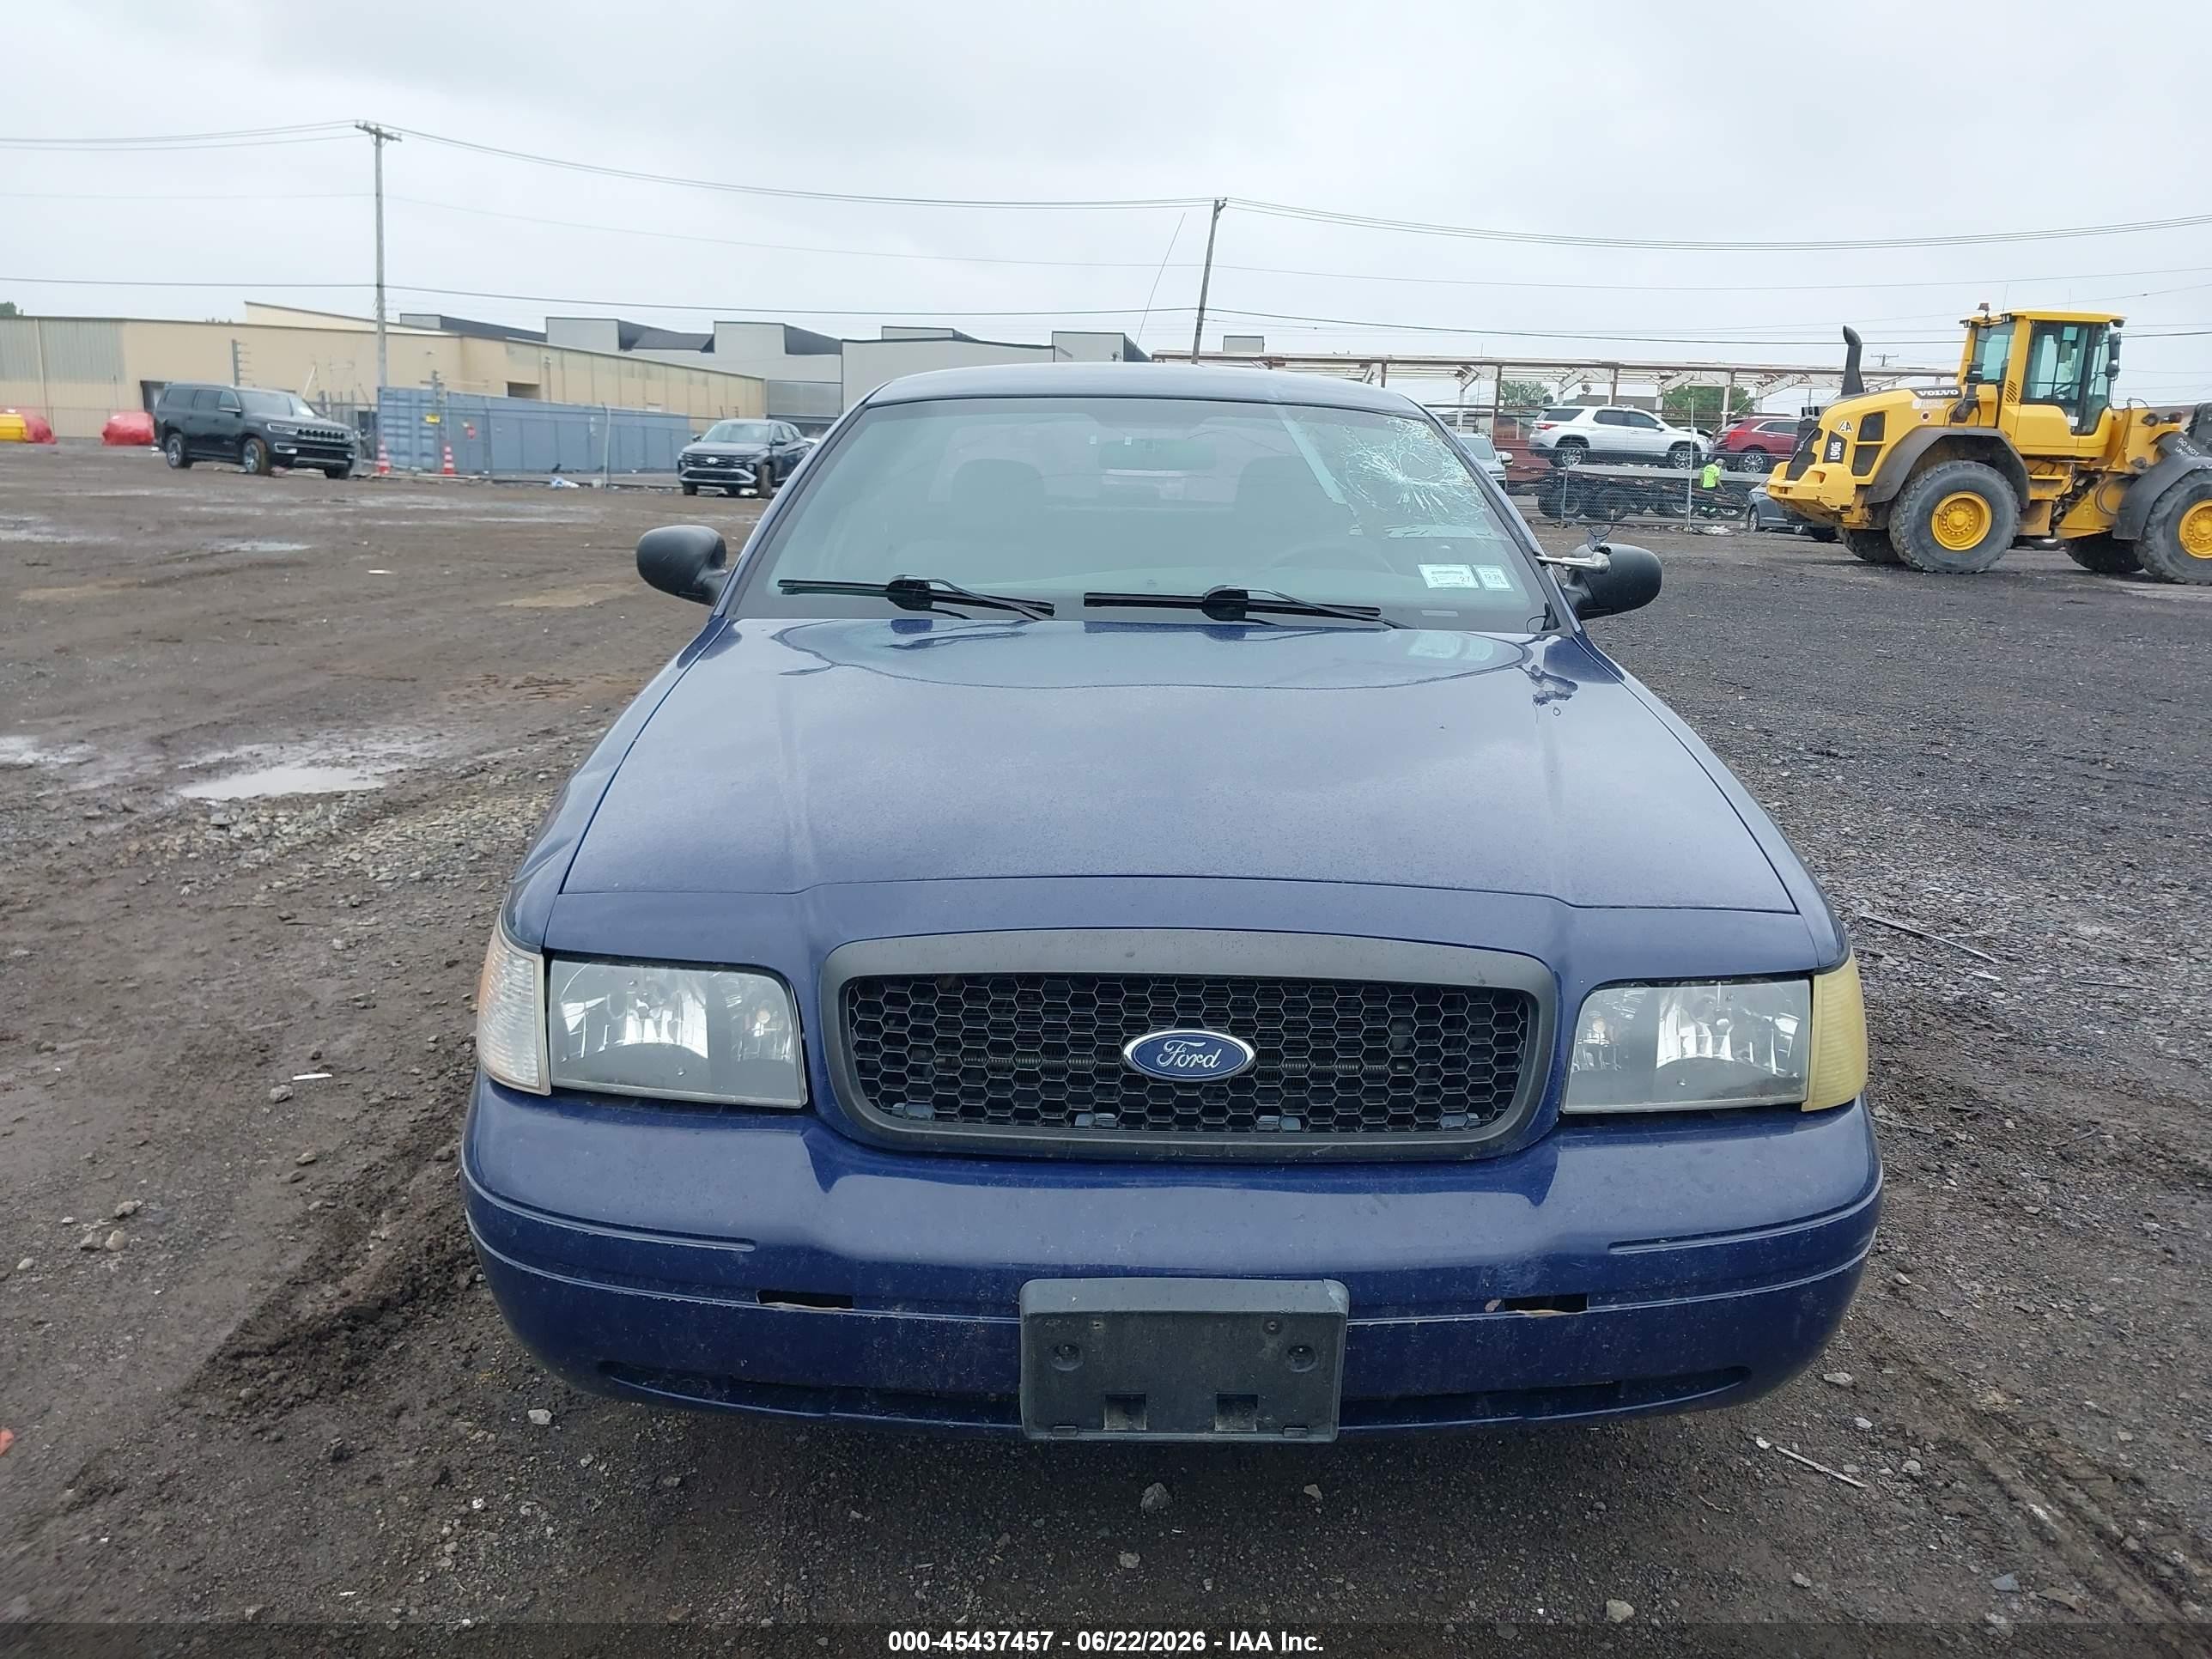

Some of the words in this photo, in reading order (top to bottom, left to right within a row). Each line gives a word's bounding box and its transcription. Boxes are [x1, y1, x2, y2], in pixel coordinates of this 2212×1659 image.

[2178, 437, 2188, 447] DO
[2185, 445, 2200, 456] NOT
[1157, 1040, 1223, 1068] Ford
